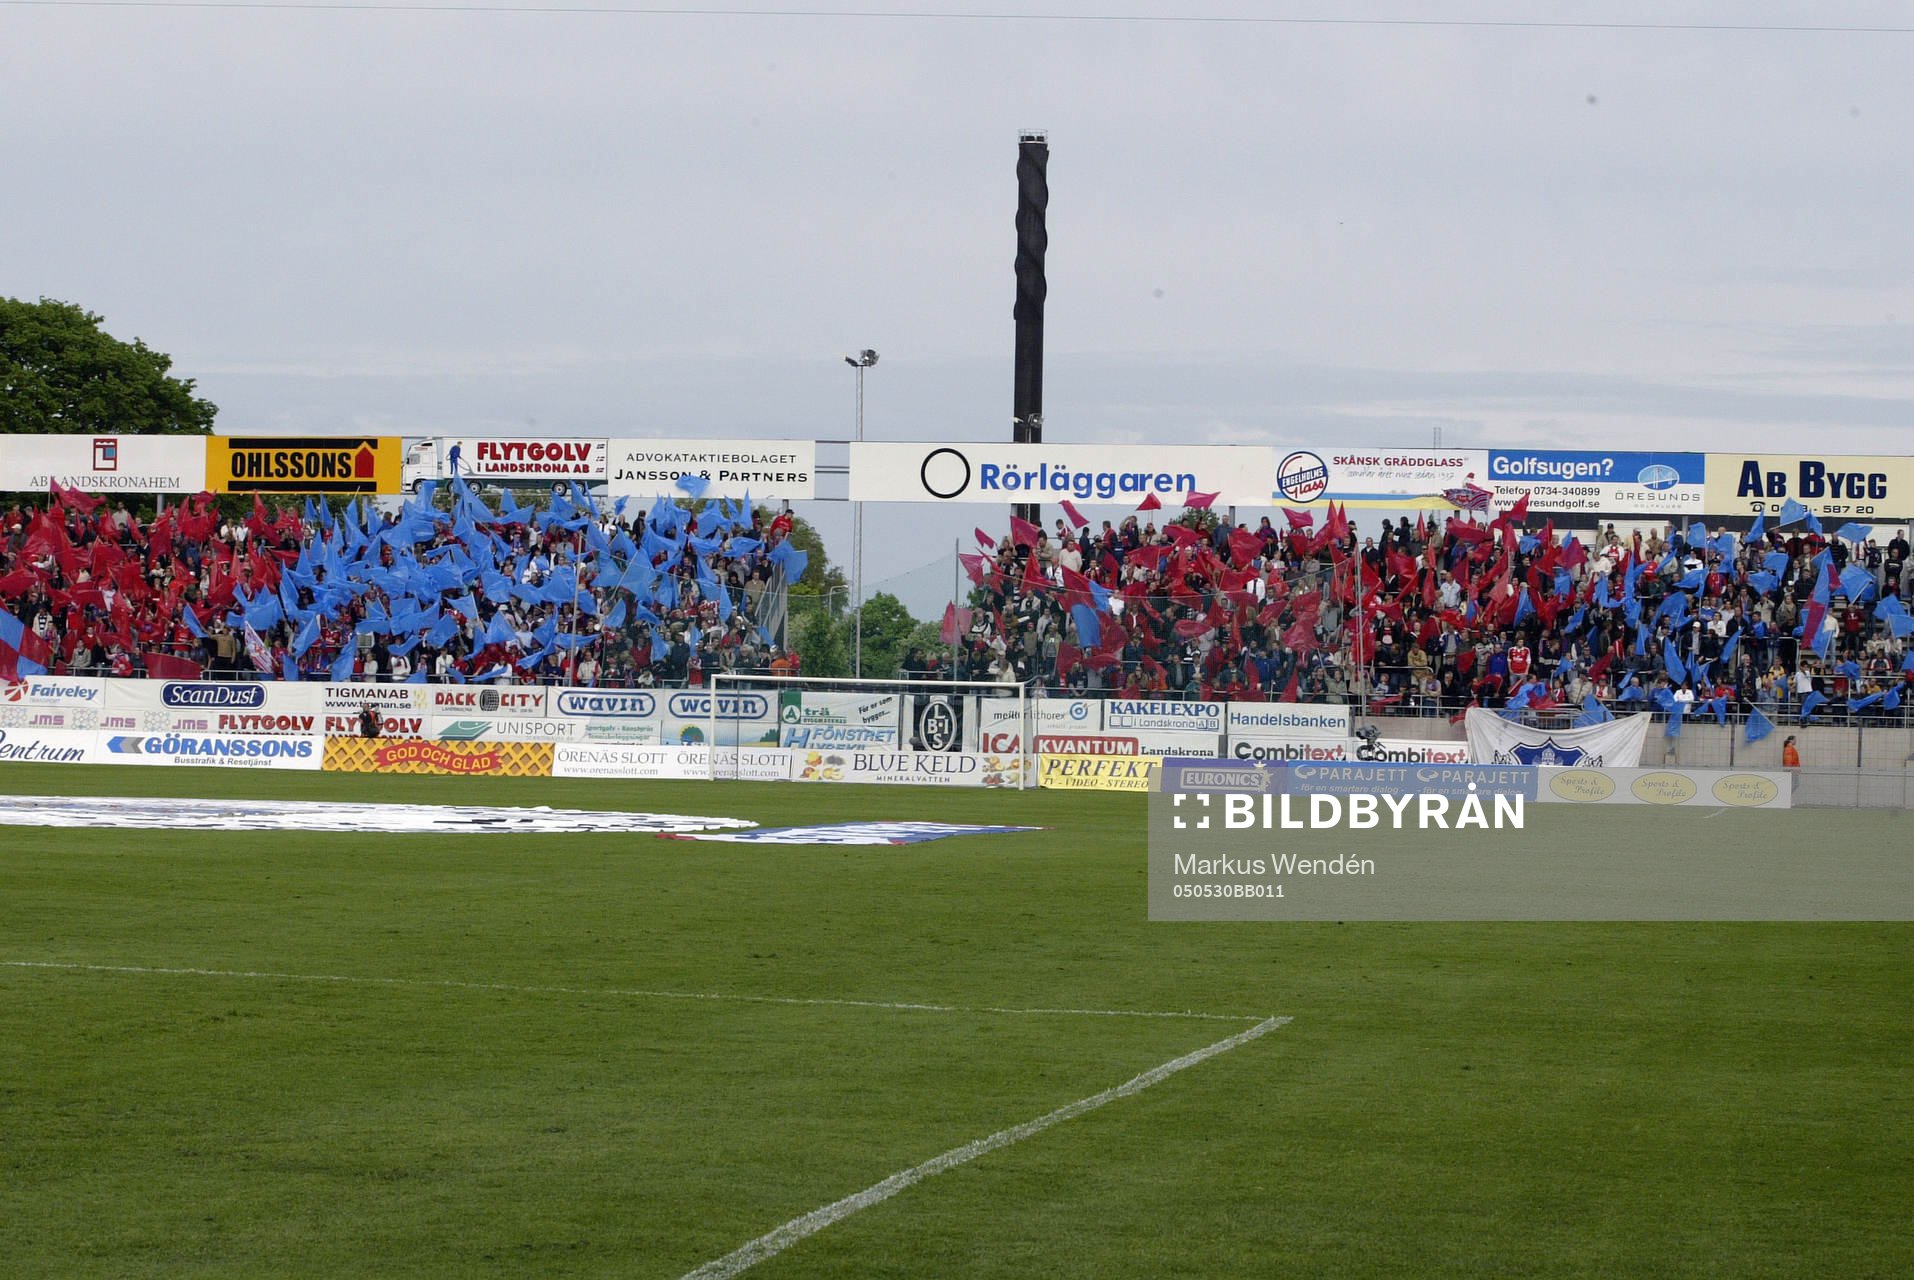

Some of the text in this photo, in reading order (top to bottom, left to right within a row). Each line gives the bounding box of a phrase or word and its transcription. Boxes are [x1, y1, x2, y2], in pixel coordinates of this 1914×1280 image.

[477, 442, 592, 461] FLYTGOLV
[626, 453, 797, 464] ADVOKATAKTIEBOLAGET
[231, 452, 352, 478] OHLSSONS
[1333, 454, 1464, 467] SKÅNSK GRÄDDGLASS
[1493, 456, 1614, 478] Golfsugen?
[486, 463, 570, 474] LANDSKRONA
[573, 464, 590, 474] AB
[700, 470, 710, 480] &
[30, 476, 48, 486] AB
[980, 463, 1196, 498] Rörläggaren
[1282, 467, 1324, 488] ENGELHOLMS
[1494, 486, 1600, 496] Telefon 0734-340899
[1615, 490, 1700, 502] ÖRESUNDS
[1856, 506, 1874, 514] 20
[30, 684, 98, 701] Faiveley
[170, 685, 258, 704] ScanDust
[436, 690, 544, 707] DÄCK CITY
[569, 698, 644, 712] wavin
[1110, 701, 1220, 718] KAKELEXPO
[218, 714, 314, 731] FLYTGOLV
[325, 716, 422, 733] FLYOLV
[1140, 718, 1196, 728] Landskrona
[1230, 712, 1346, 728] Handelsbanken
[497, 722, 576, 736] UNISPORT
[812, 725, 896, 742] FÖNSTRET
[144, 732, 313, 758] GÖRANSSONS
[982, 732, 1214, 756] ICA KVANTUM Landskrona
[1234, 742, 1344, 760] Combitext
[174, 756, 272, 766] Busstrafik & Resetjänst
[386, 746, 491, 770] GOD OCH GLAD
[558, 748, 667, 764] ÖRENÄS SLOTT
[741, 754, 788, 766] SLOTT
[1356, 745, 1466, 763] Combitext
[853, 753, 976, 774] BLUE KELD
[1046, 758, 1158, 778] PERFEKT
[564, 766, 659, 776] www.orenasslott.com
[1320, 768, 1408, 782] PARAJETT
[1442, 770, 1530, 784] PARAJETT
[1044, 778, 1054, 786] TV
[1066, 778, 1098, 788] VIDEO
[1108, 778, 1149, 788] STEREO
[1186, 772, 1260, 786] EURONICS
[1560, 776, 1588, 786] Sports
[1642, 779, 1670, 789] Sports
[1723, 781, 1750, 791] Sports
[1301, 784, 1314, 792] för
[1371, 786, 1399, 794] dialog
[1574, 785, 1605, 796] Profile
[1656, 788, 1686, 798] Profile
[1737, 790, 1768, 800] Profile
